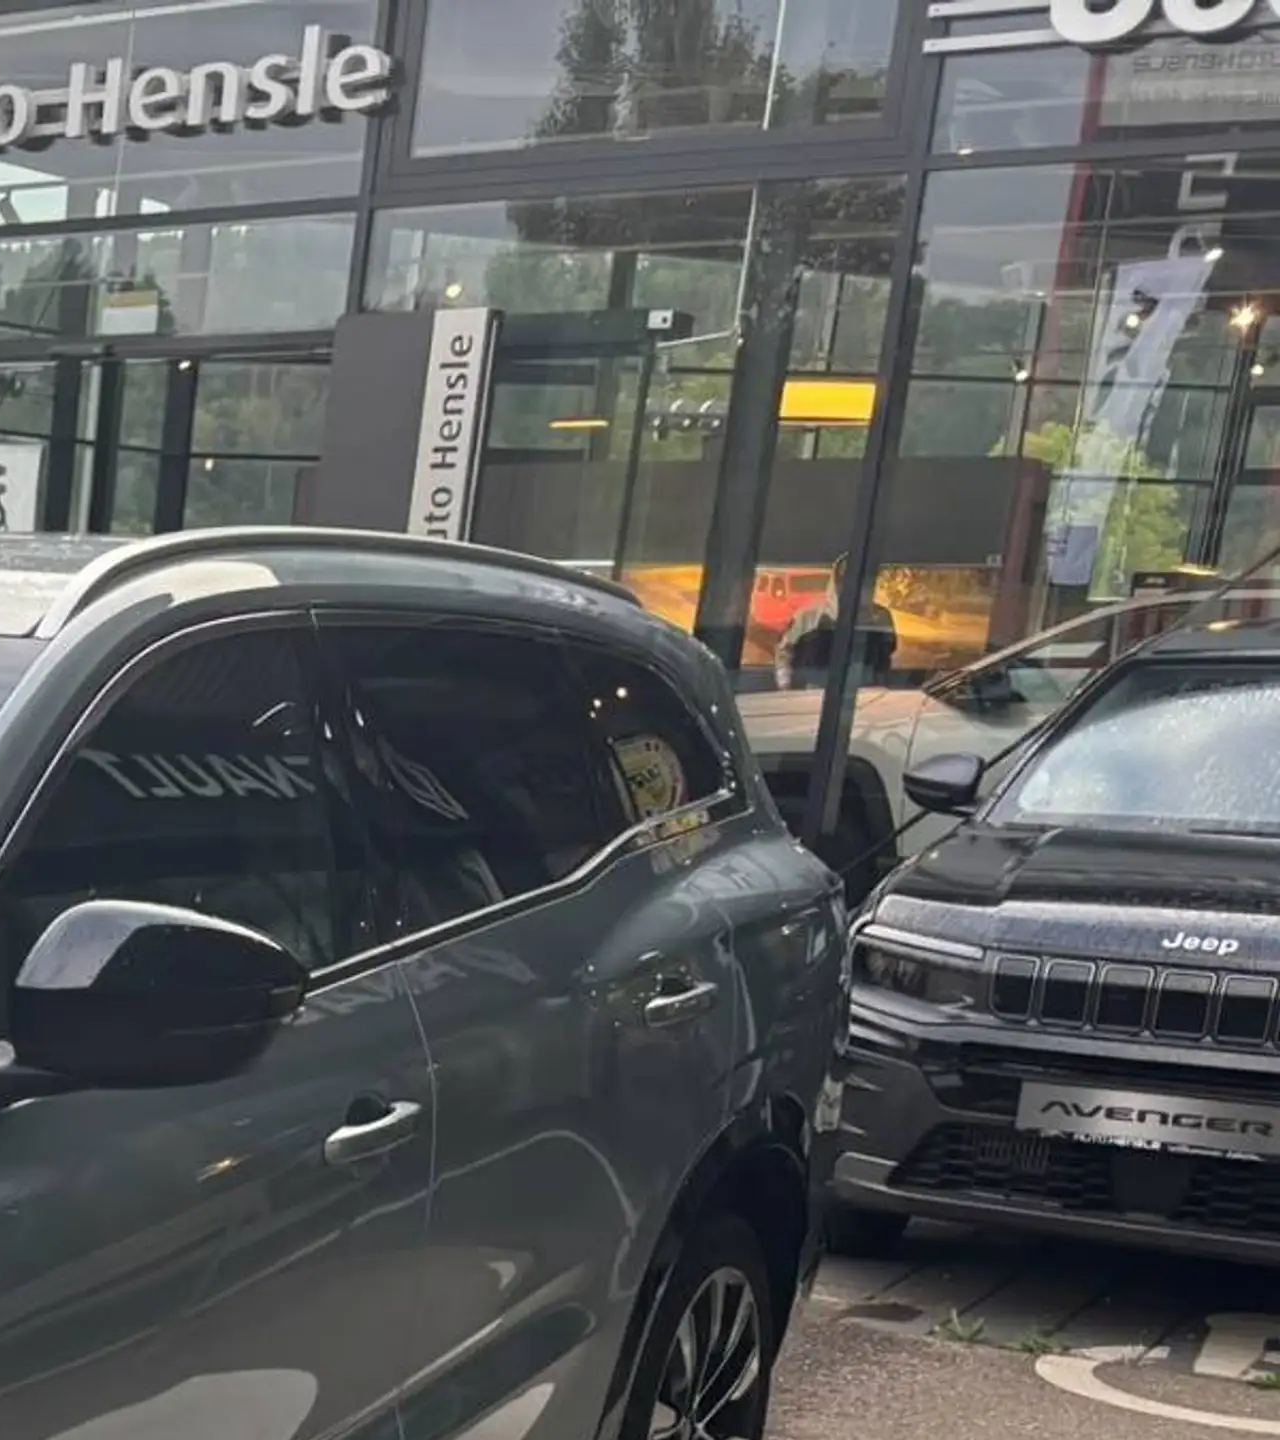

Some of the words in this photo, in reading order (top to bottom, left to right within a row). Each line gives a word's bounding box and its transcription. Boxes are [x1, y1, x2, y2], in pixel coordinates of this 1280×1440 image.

[64, 24, 390, 137] Hensle
[430, 334, 473, 469] Hensle
[1161, 931, 1240, 956] Jeep
[1041, 1100, 1274, 1138] AVENGER
